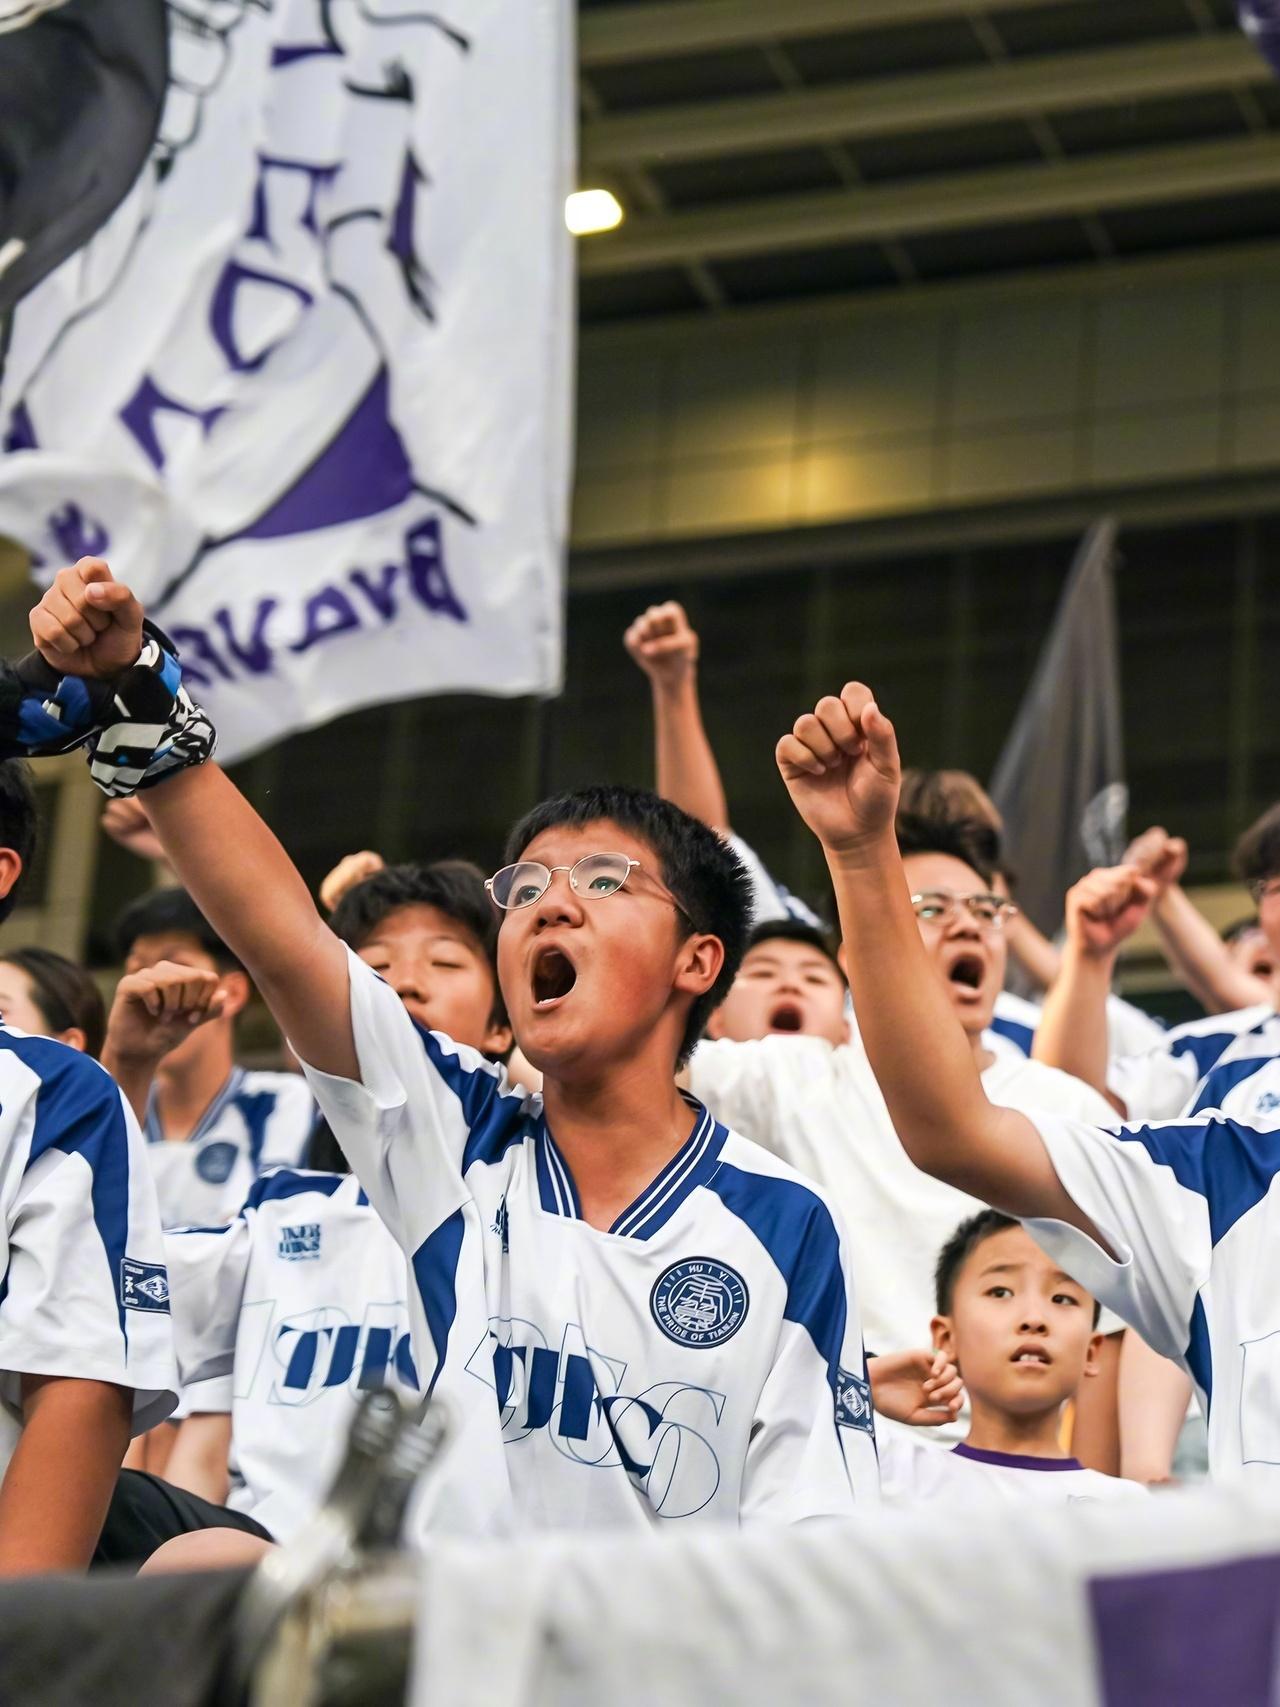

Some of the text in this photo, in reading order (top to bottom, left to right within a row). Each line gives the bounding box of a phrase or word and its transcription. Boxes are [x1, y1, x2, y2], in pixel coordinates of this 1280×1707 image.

[657, 1295, 740, 1341] THE PRIDE OF TIANJIN
